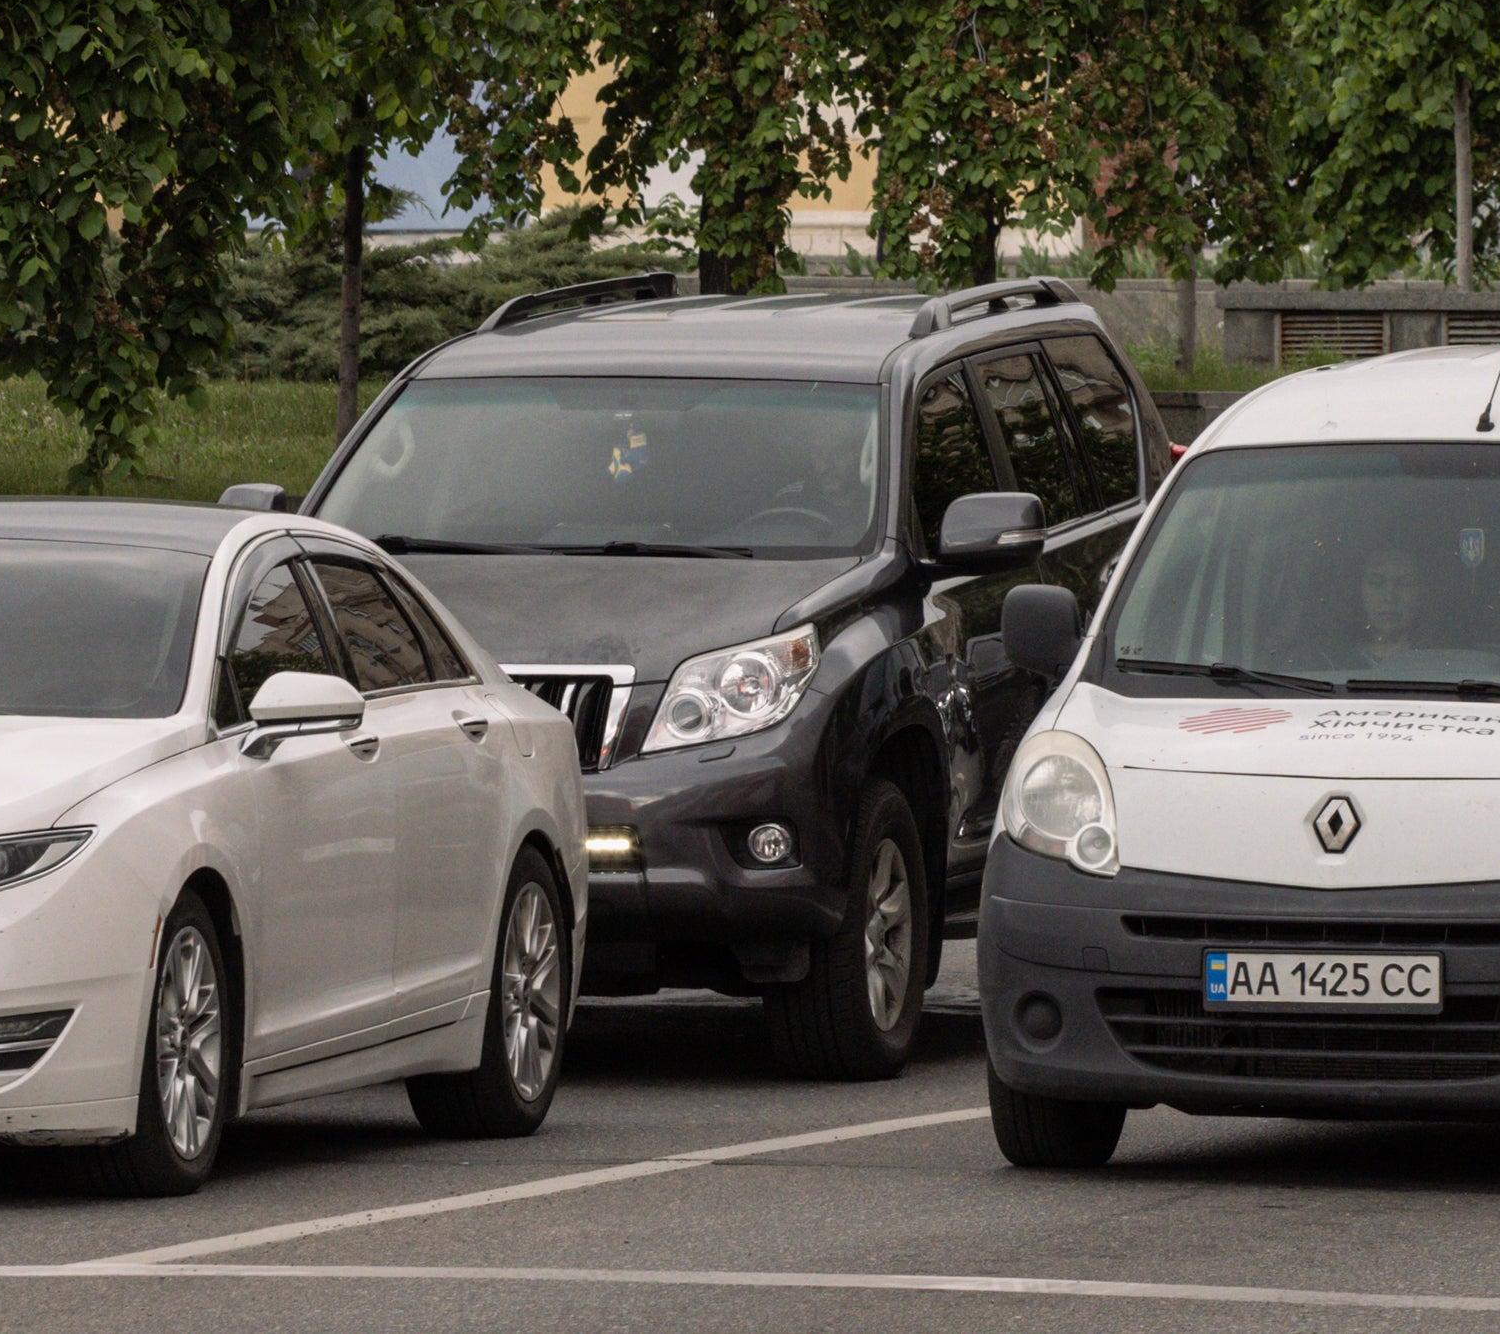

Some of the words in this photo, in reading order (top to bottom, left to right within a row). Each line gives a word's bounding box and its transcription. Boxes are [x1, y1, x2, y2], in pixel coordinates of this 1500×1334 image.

[1308, 719, 1496, 736] Хімчистка
[1298, 732, 1356, 741] since
[1365, 732, 1415, 743] 1994
[1211, 983, 1225, 994] UA
[1230, 962, 1280, 996] AA
[1291, 962, 1370, 997] 1425
[1381, 963, 1432, 998] CC
